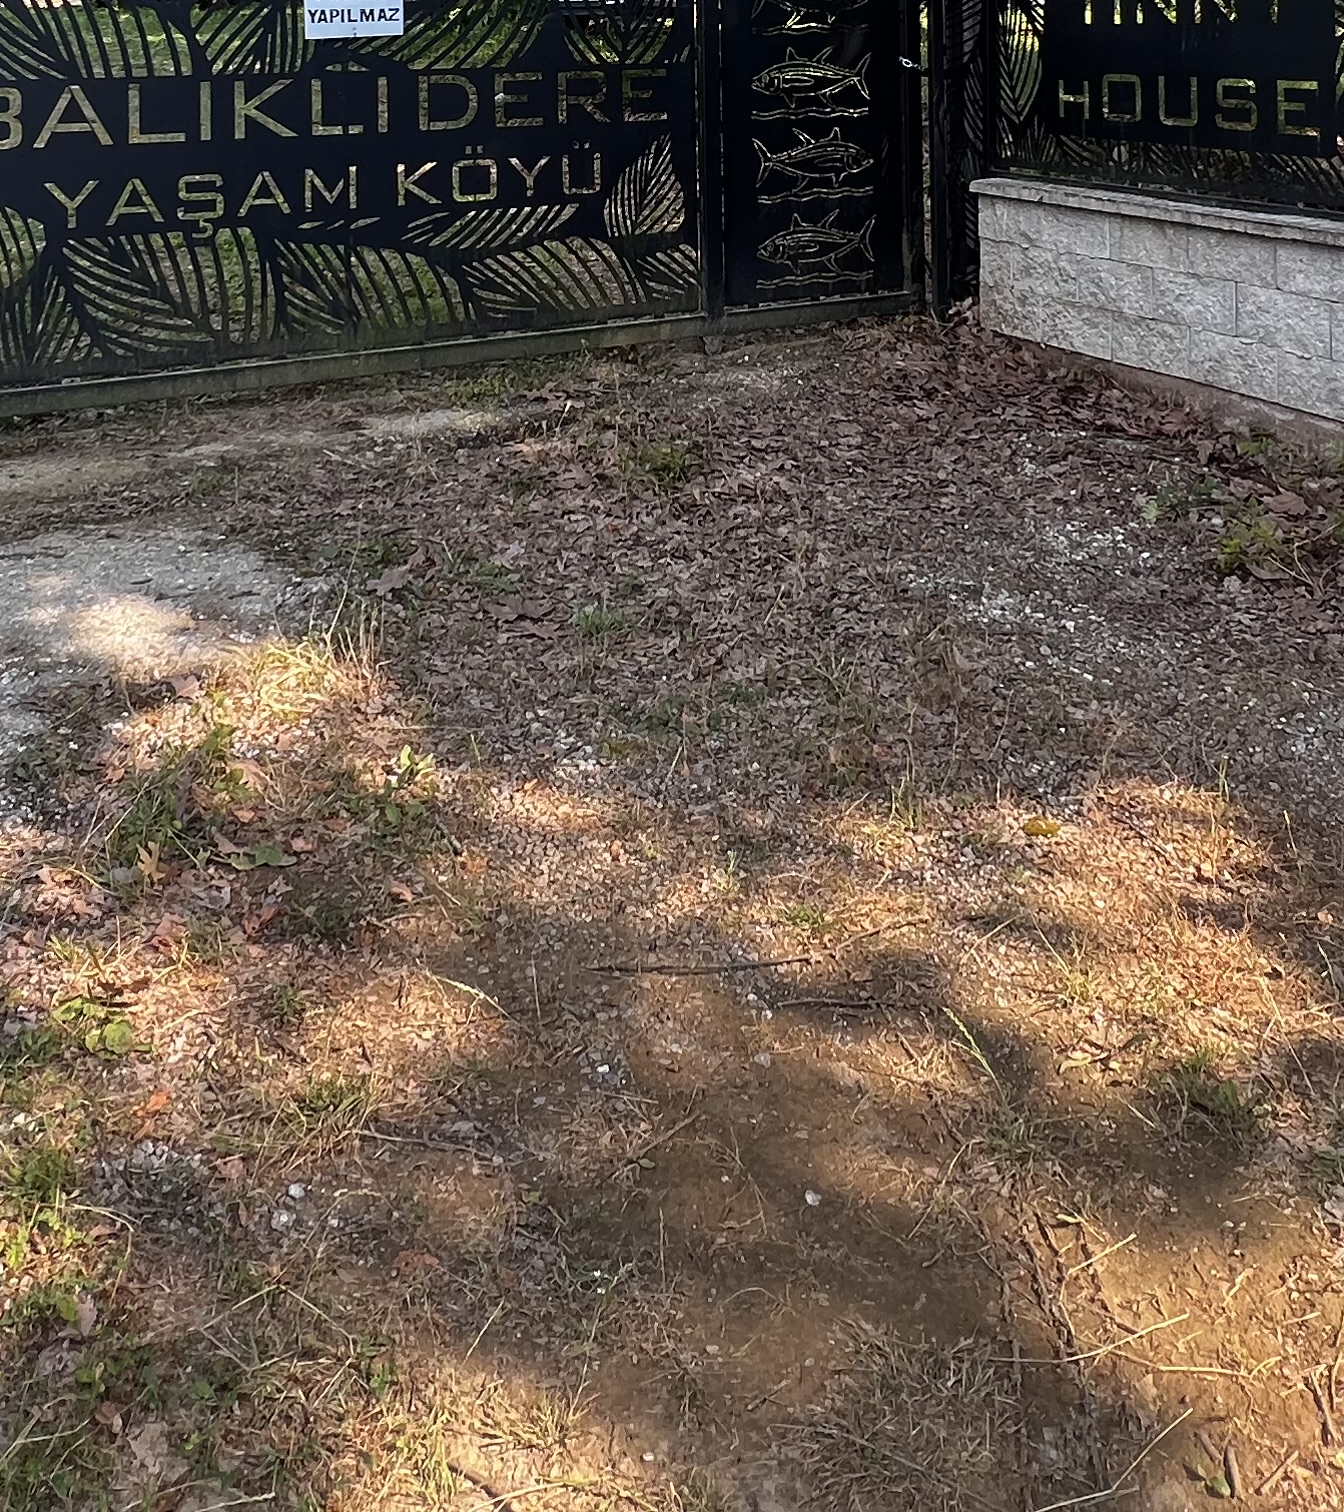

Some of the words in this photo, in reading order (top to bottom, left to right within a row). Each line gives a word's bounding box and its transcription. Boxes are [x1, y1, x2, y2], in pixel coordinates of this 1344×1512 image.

[307, 8, 400, 23] YAPILMAZ
[1058, 73, 1322, 137] HOUSE
[43, 164, 361, 239] YAŞAM
[395, 143, 602, 208] KÖYÜ
